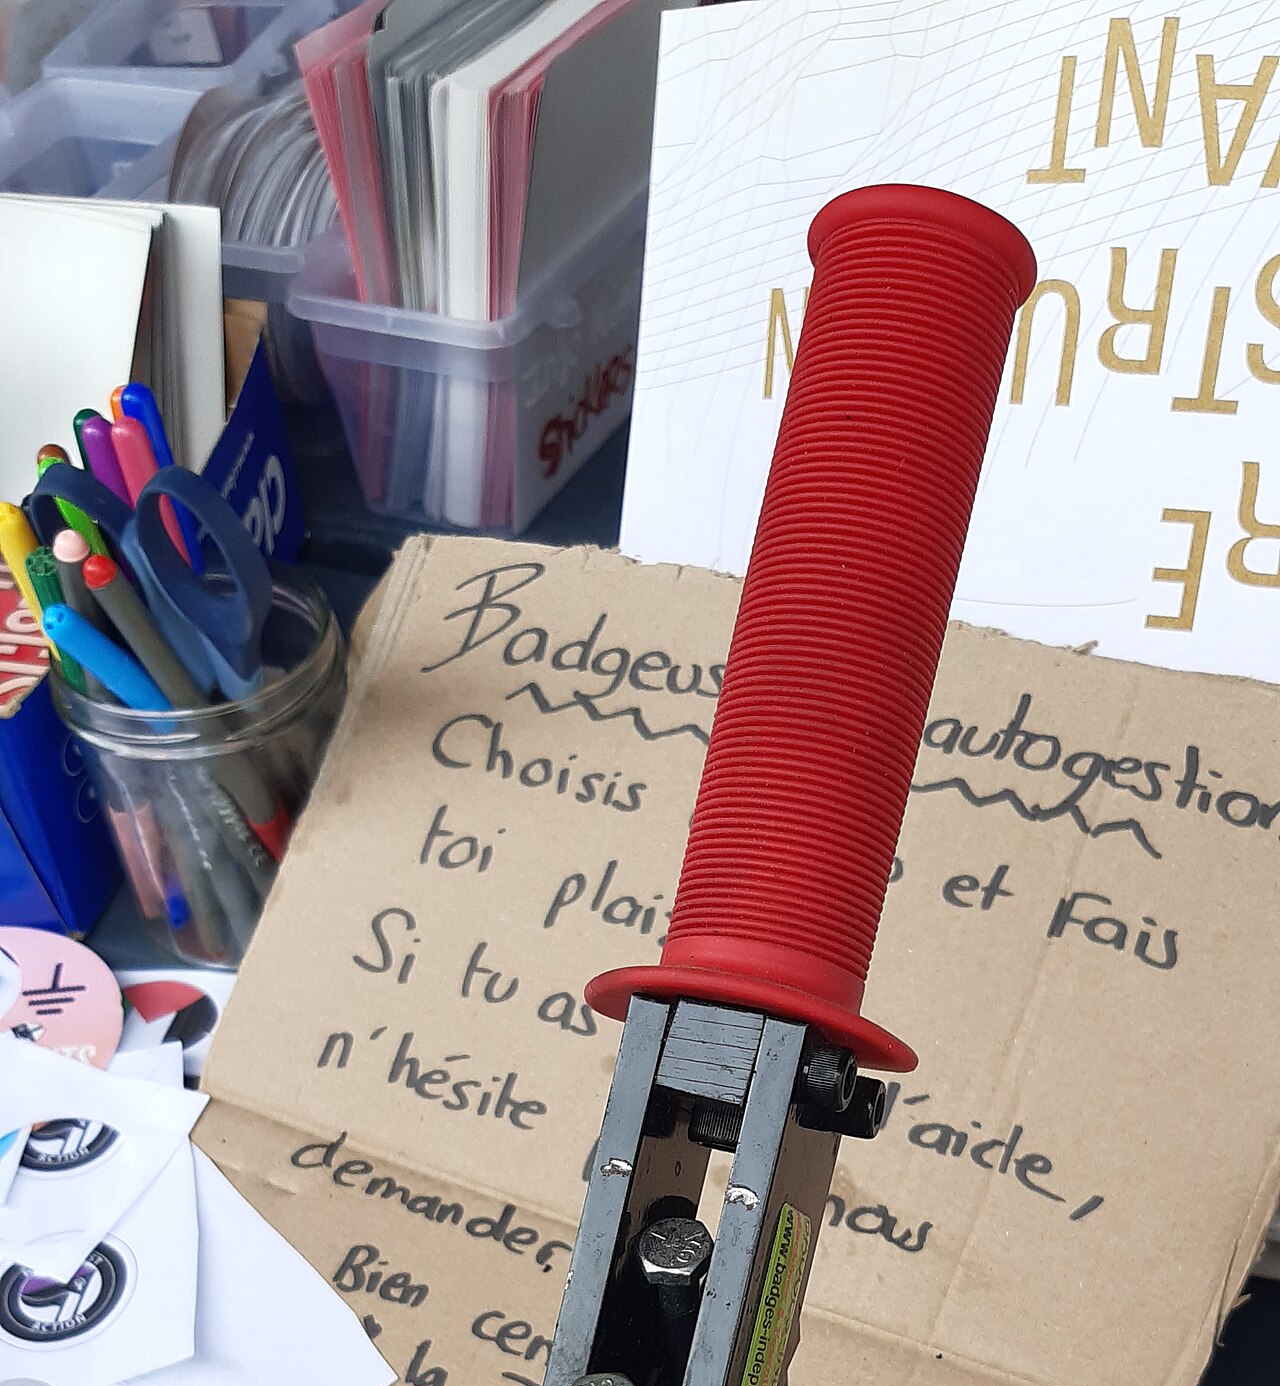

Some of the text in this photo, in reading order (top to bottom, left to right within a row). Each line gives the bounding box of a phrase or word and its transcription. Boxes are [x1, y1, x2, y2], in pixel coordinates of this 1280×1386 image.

[1026, 17, 1280, 188] ANT
[421, 562, 724, 698] Badgeus
[419, 804, 673, 950] toi plai
[432, 713, 647, 813] Choisis
[941, 864, 1014, 911] et
[353, 906, 422, 985] Si
[461, 941, 519, 1004] tu
[537, 990, 599, 1037] as
[332, 1243, 554, 1367] Bien cen
